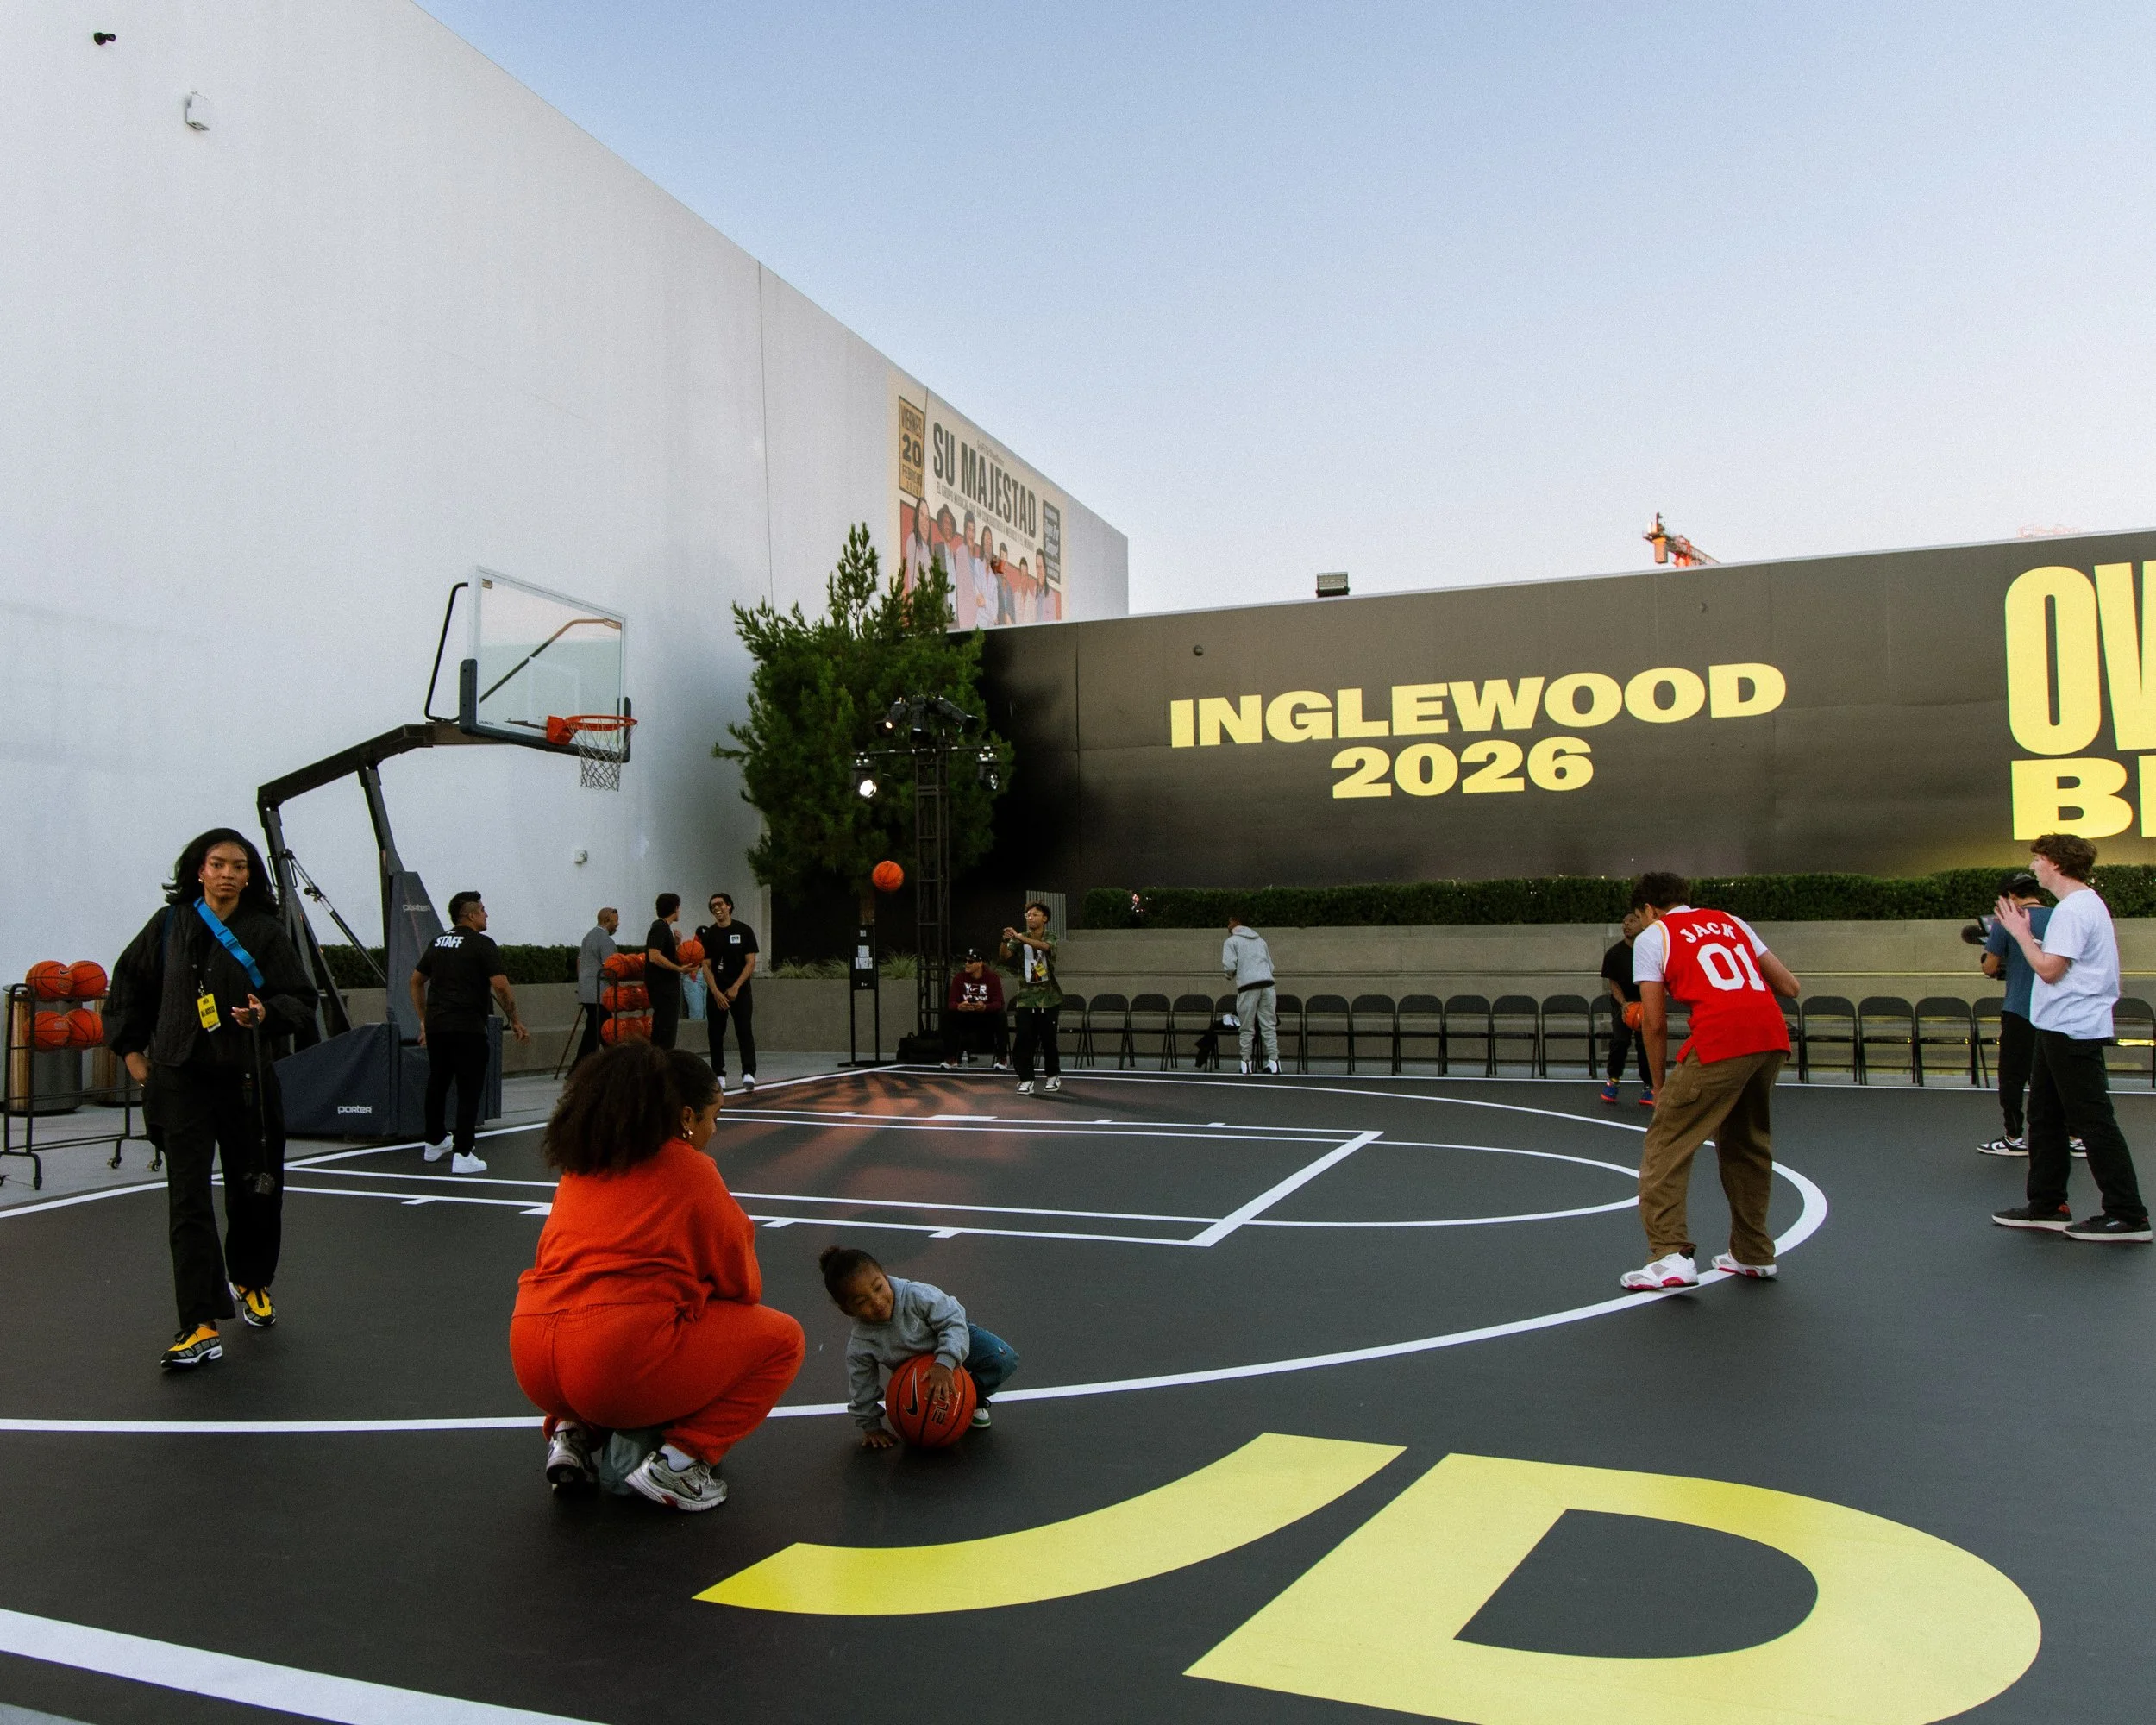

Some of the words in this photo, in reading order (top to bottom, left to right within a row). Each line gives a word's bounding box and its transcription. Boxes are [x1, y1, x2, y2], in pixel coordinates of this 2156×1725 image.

[902, 432, 922, 468] 20
[933, 422, 955, 486] SU
[961, 441, 1037, 539] MAJESTAD
[1169, 662, 1787, 749] INGLEWOOD
[1331, 736, 1594, 799] 2026
[2011, 755, 2156, 841] B
[434, 935, 465, 949] STAFF
[1679, 922, 1736, 944] JACK
[1696, 942, 1766, 992] 01
